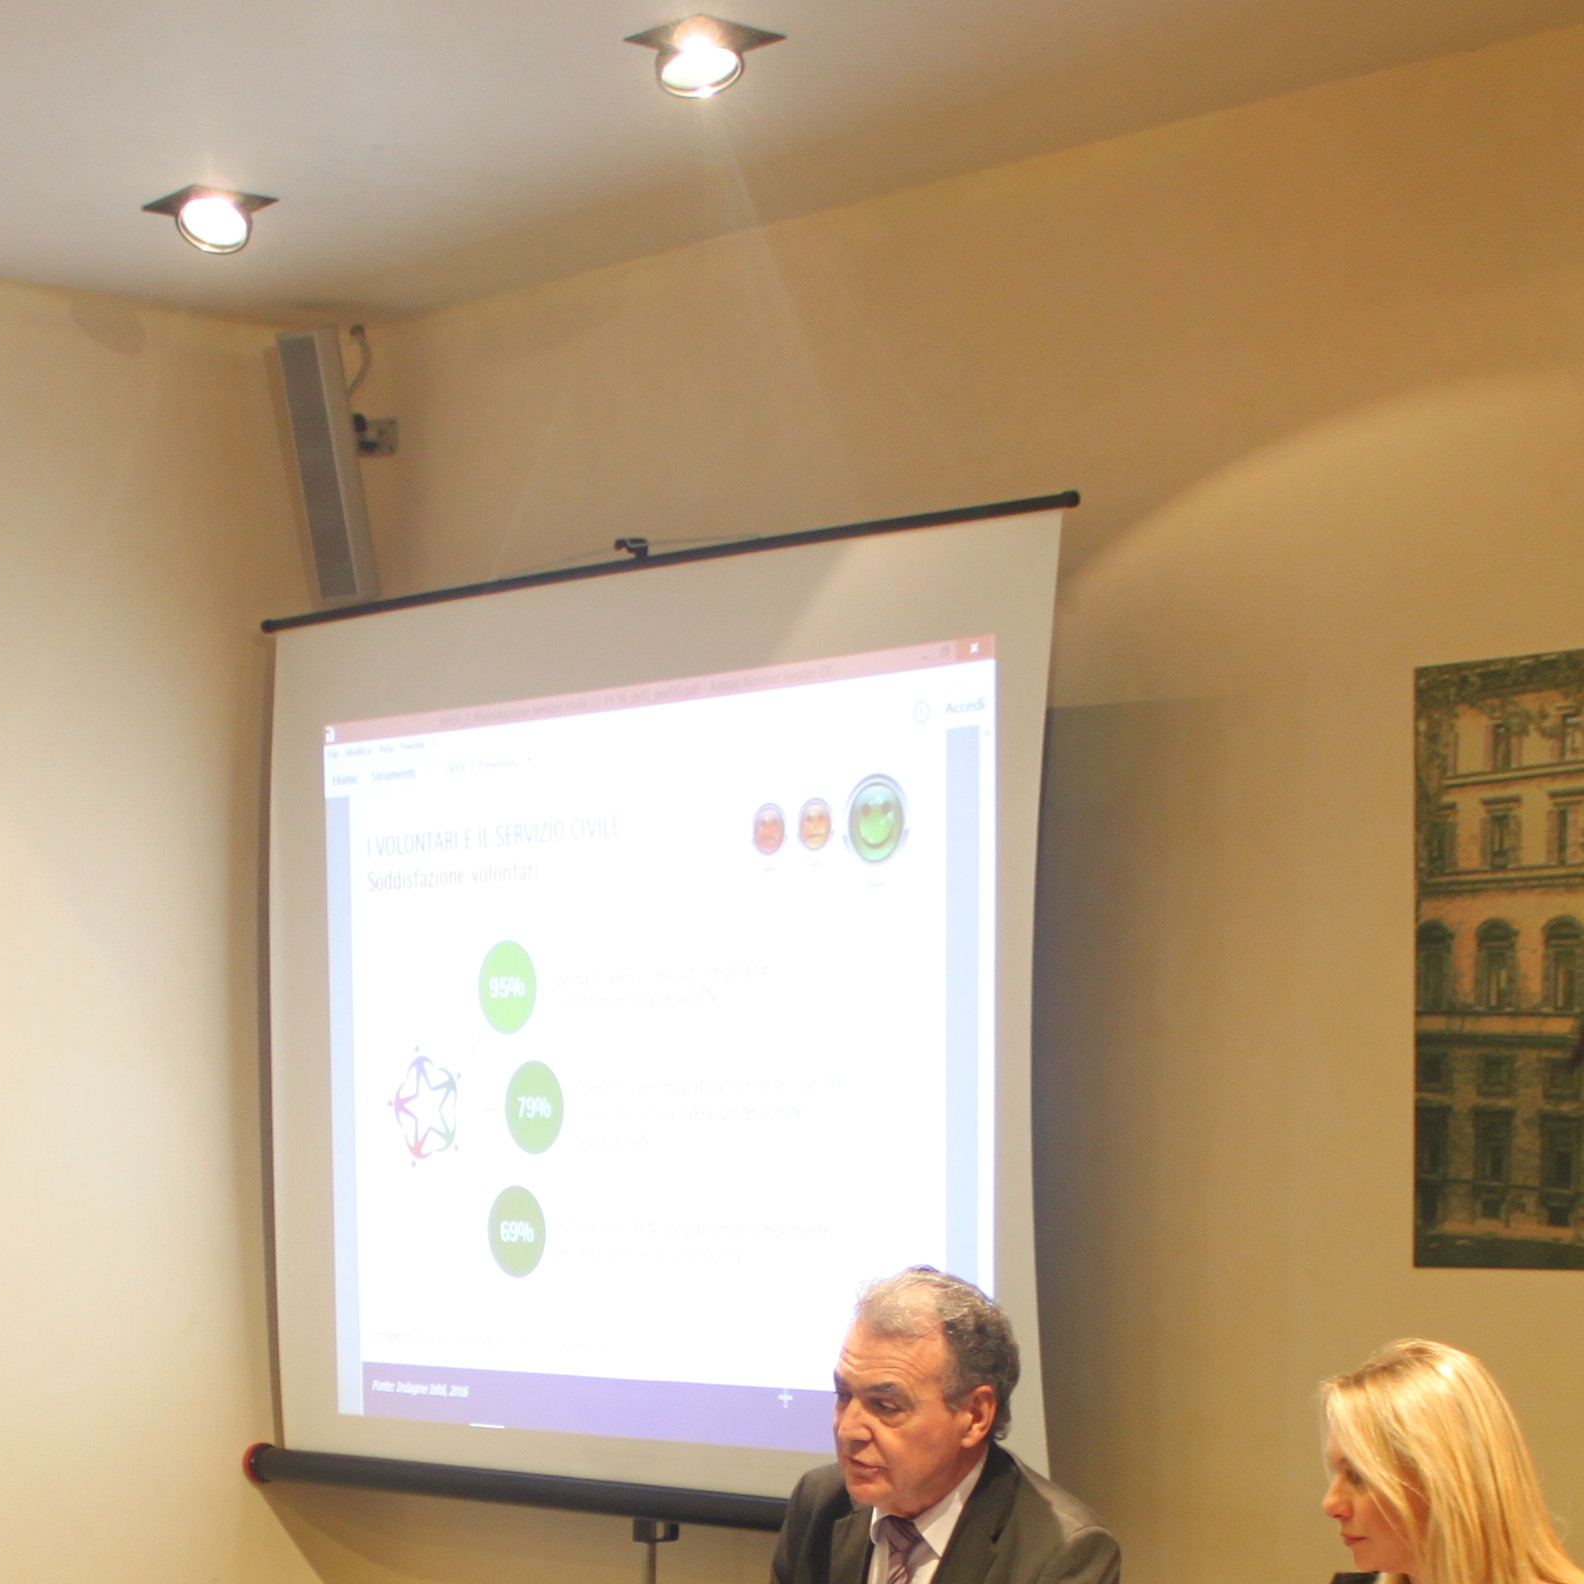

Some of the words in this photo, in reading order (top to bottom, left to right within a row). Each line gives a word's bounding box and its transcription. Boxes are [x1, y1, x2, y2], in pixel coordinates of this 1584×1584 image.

[367, 837, 372, 857] I
[375, 829, 459, 856] VOLONTARI
[464, 828, 472, 849] E
[478, 827, 490, 848] IL
[495, 819, 565, 847] SERVIZIO
[571, 814, 620, 840] CIVILE
[367, 868, 466, 892] Soddisfazione
[471, 863, 539, 885] volontari
[488, 976, 526, 999] 95%
[517, 1096, 552, 1119] 79%
[499, 1220, 535, 1243] 69%
